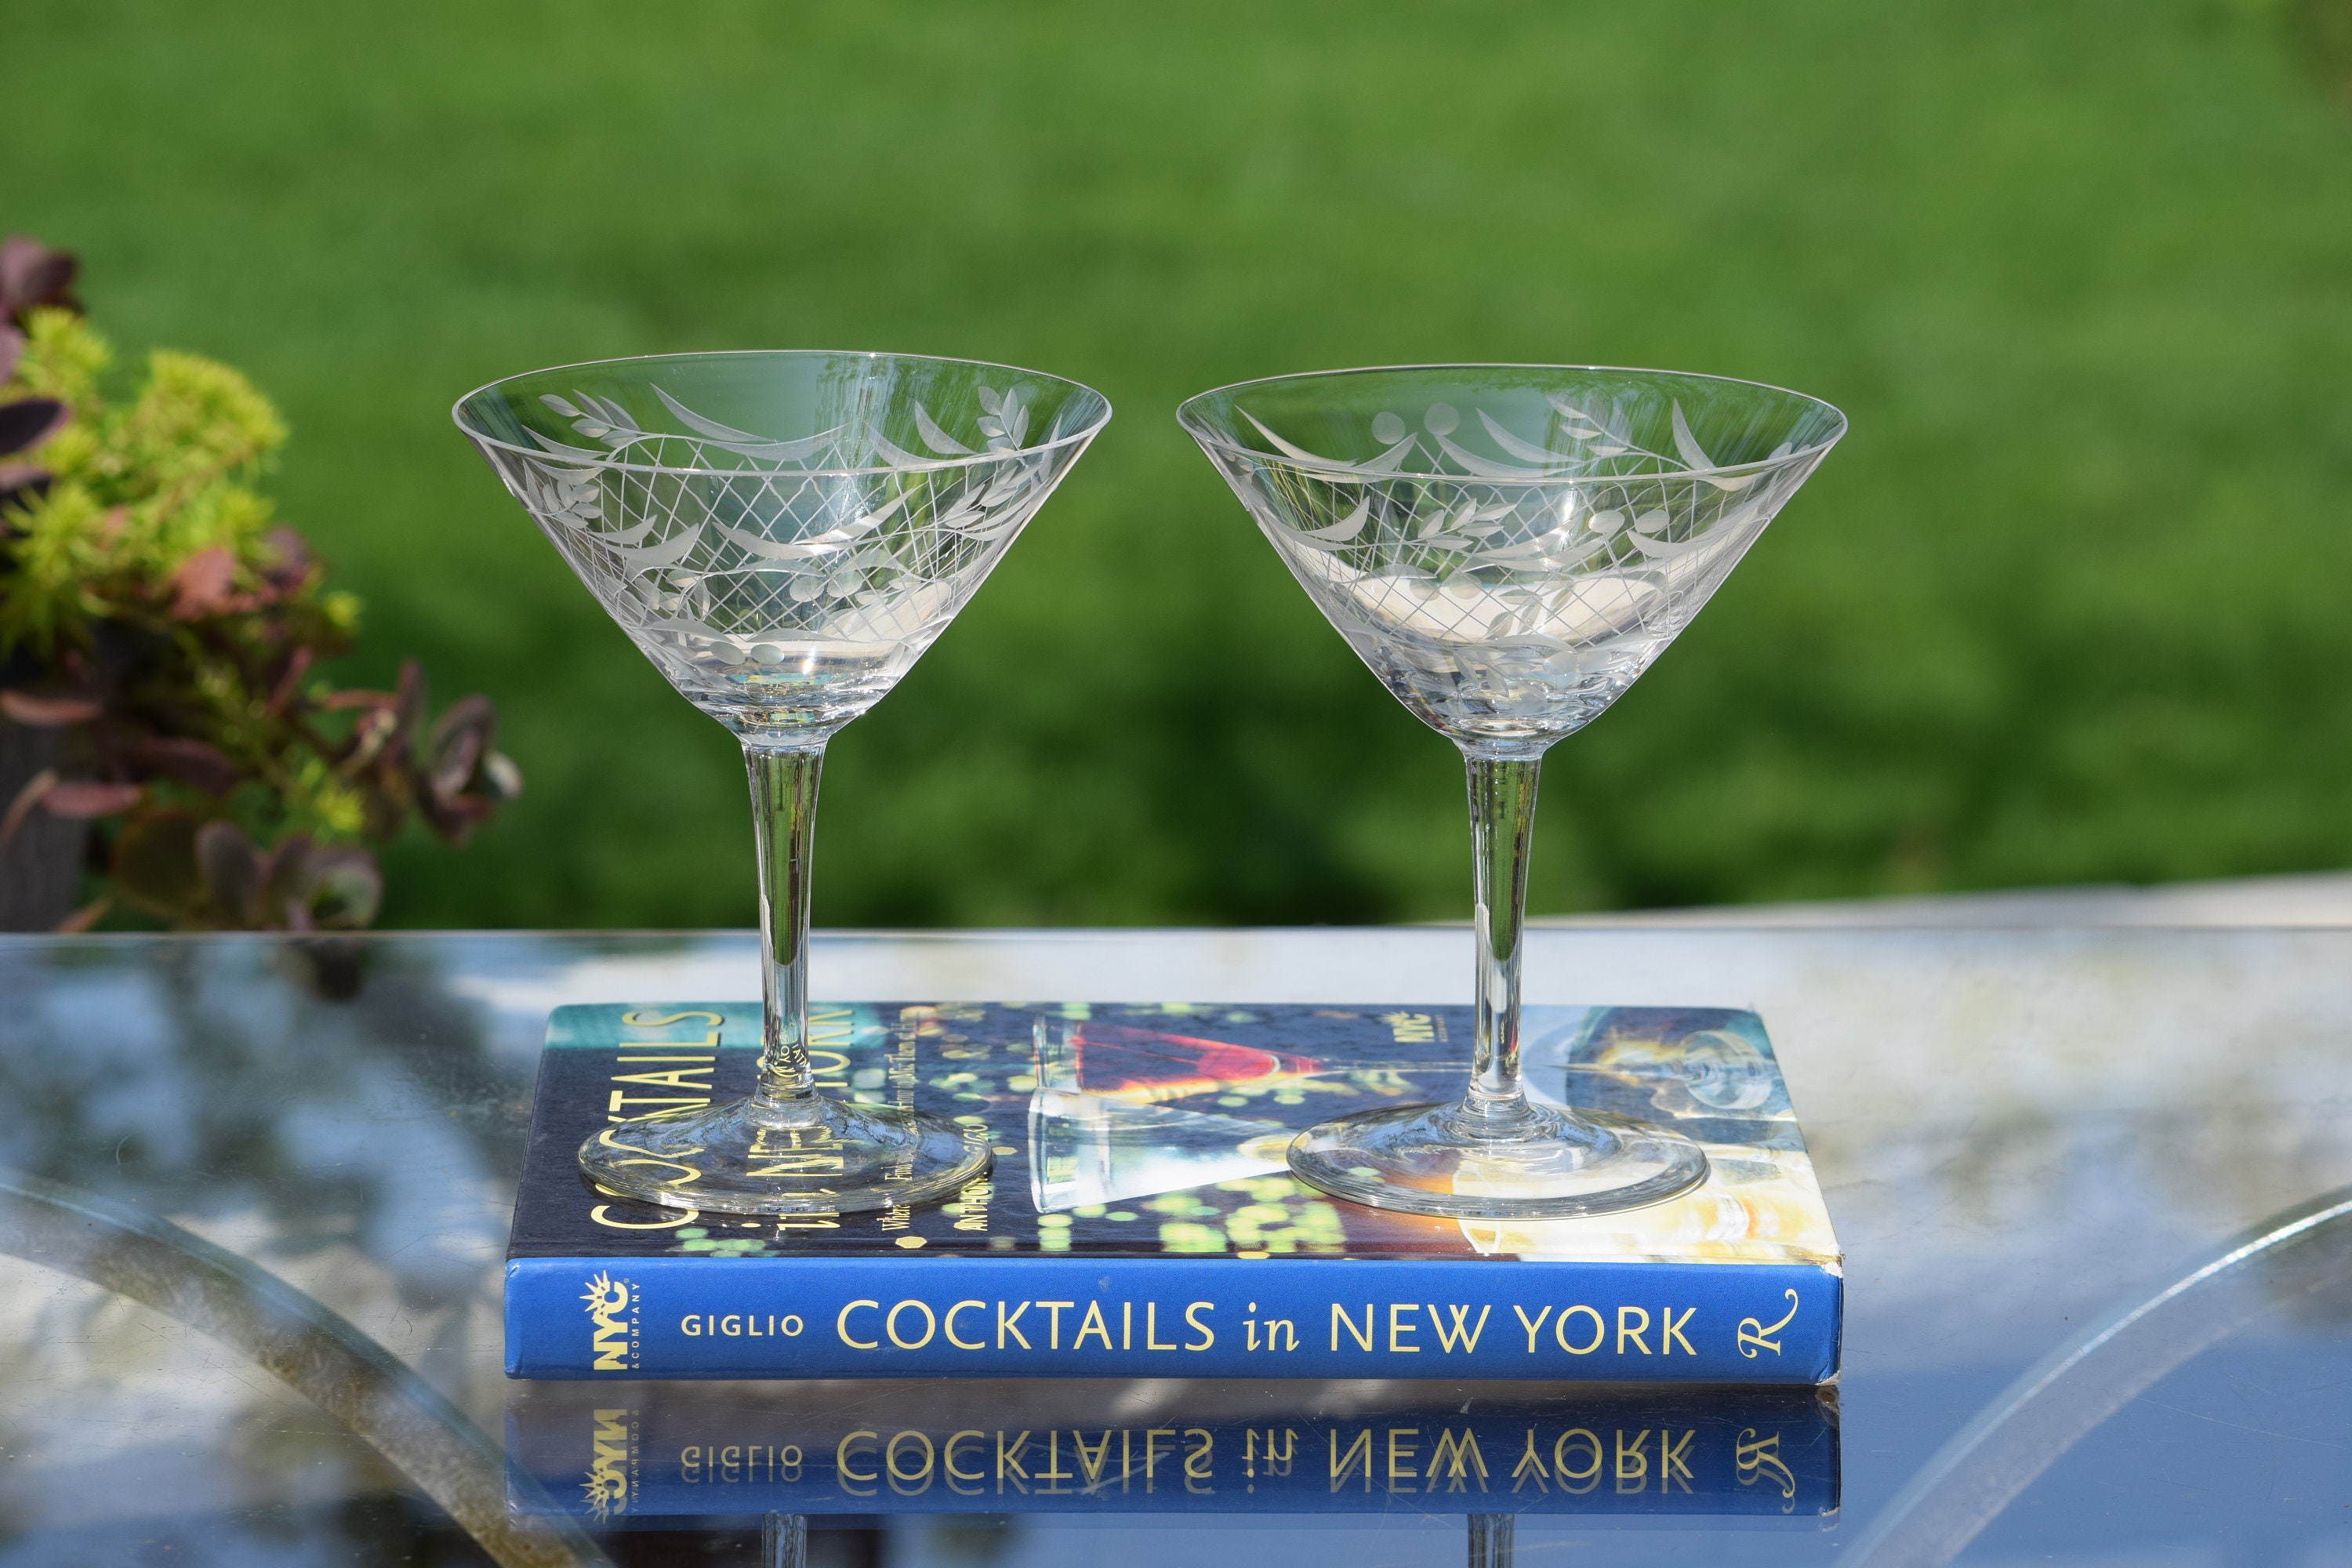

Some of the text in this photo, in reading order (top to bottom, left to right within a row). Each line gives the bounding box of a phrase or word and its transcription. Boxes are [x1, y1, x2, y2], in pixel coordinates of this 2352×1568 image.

[960, 1172, 988, 1232] ANTHON
[588, 1276, 628, 1370] NYC
[631, 1283, 641, 1359] COMPANY
[681, 1315, 803, 1337] GIGLIO
[837, 1299, 1697, 1356] COCKTAILS in NEW YORK
